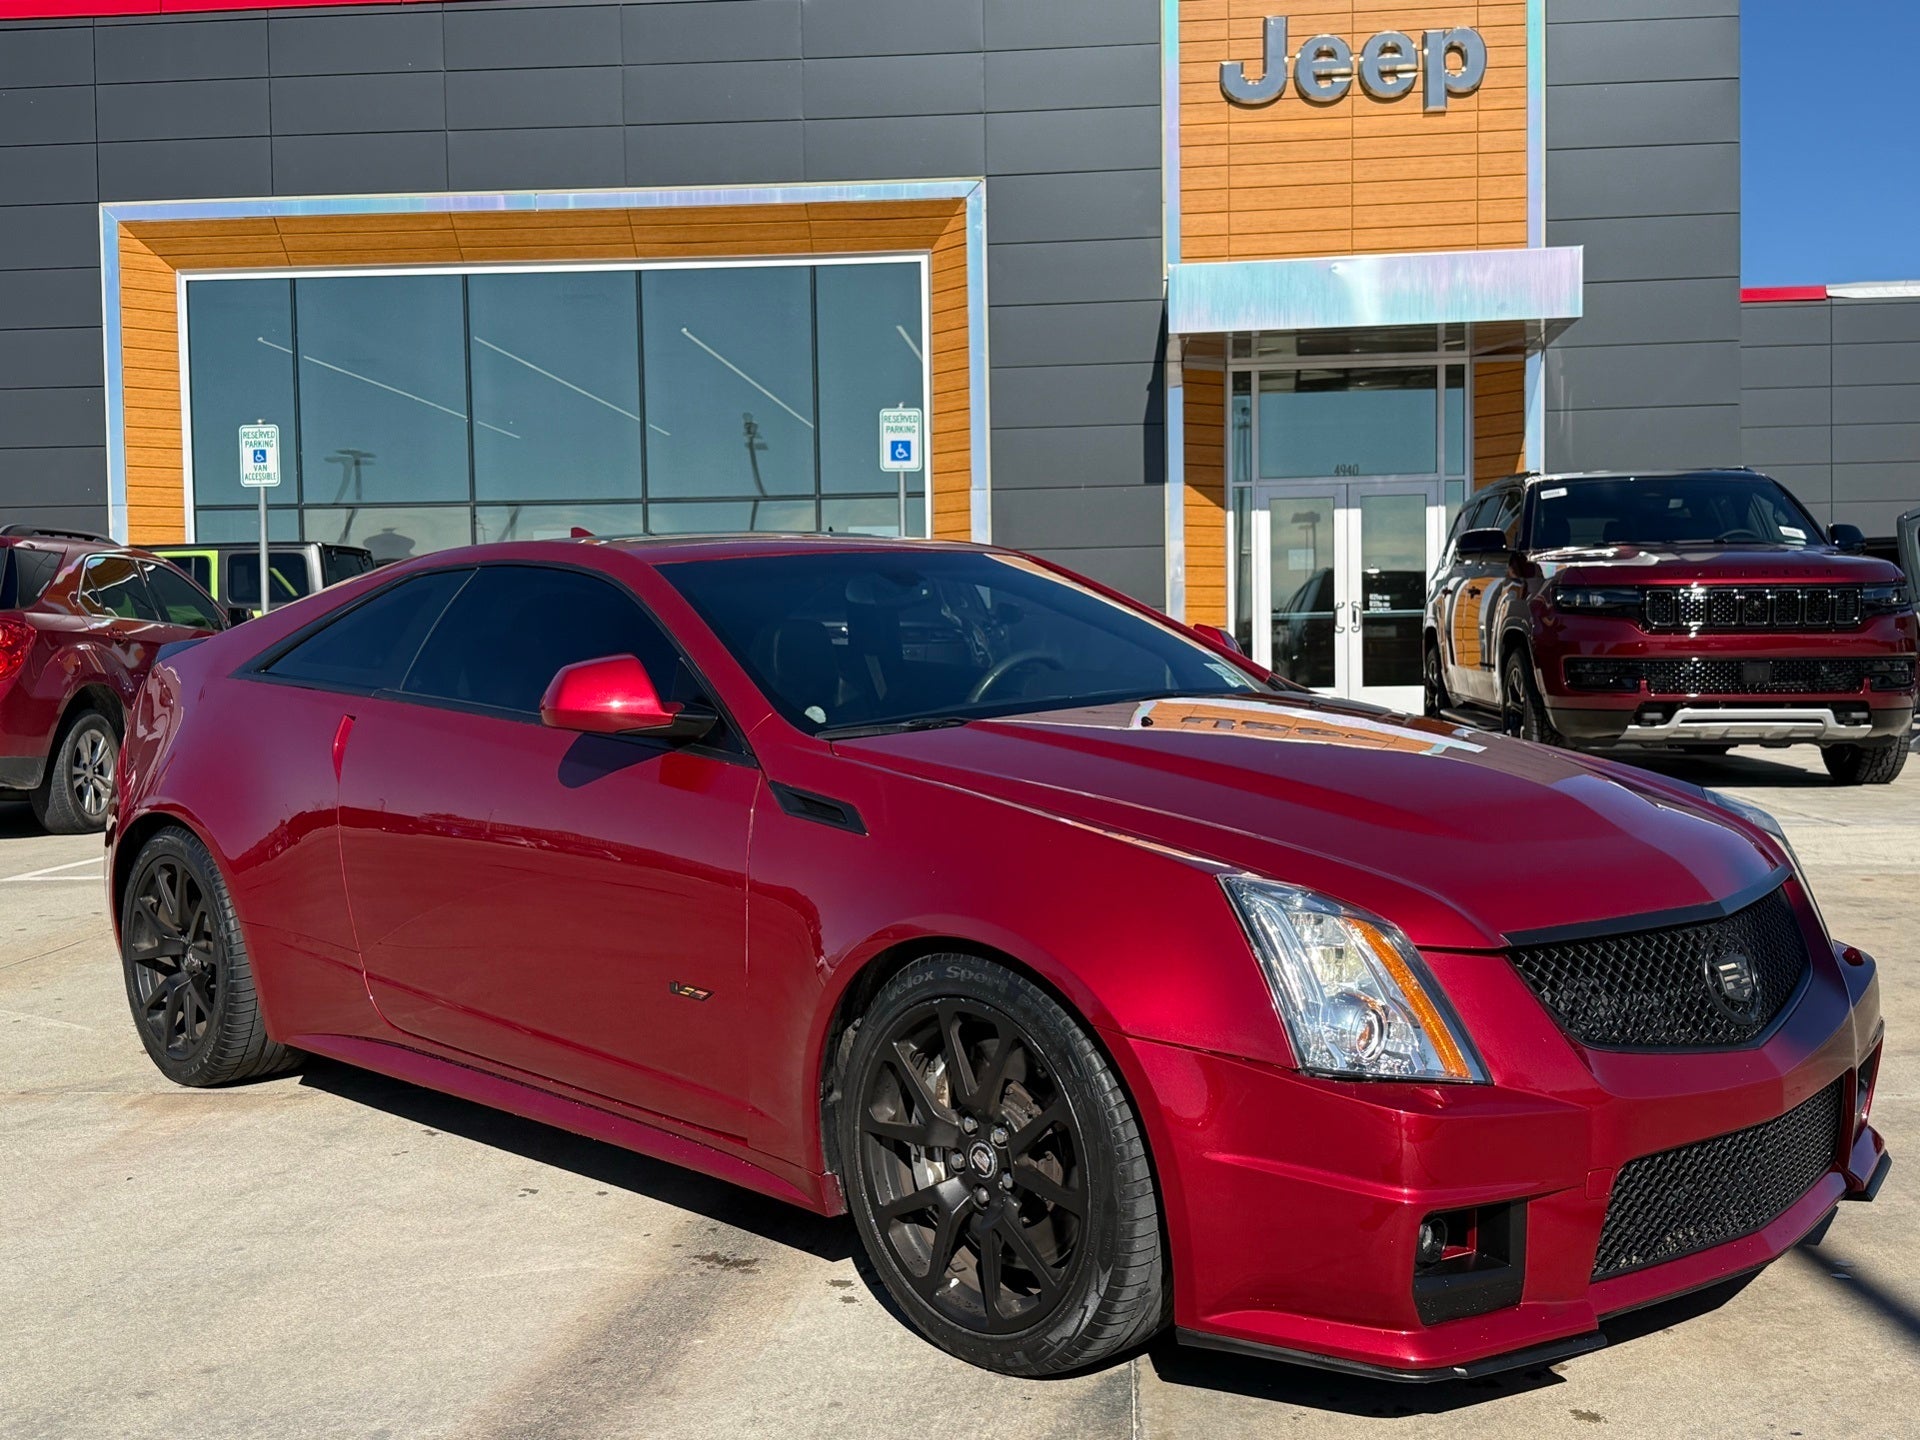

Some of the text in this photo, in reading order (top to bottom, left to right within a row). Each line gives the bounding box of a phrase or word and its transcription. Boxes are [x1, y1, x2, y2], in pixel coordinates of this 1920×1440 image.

[1219, 15, 1487, 113] Jeep
[883, 415, 918, 423] RESERVED
[886, 425, 916, 433] PARKING
[242, 431, 276, 439] RESERVED
[245, 440, 274, 448] PARKING
[1334, 463, 1359, 477] 4940
[244, 472, 277, 481] ACCESSIBLE
